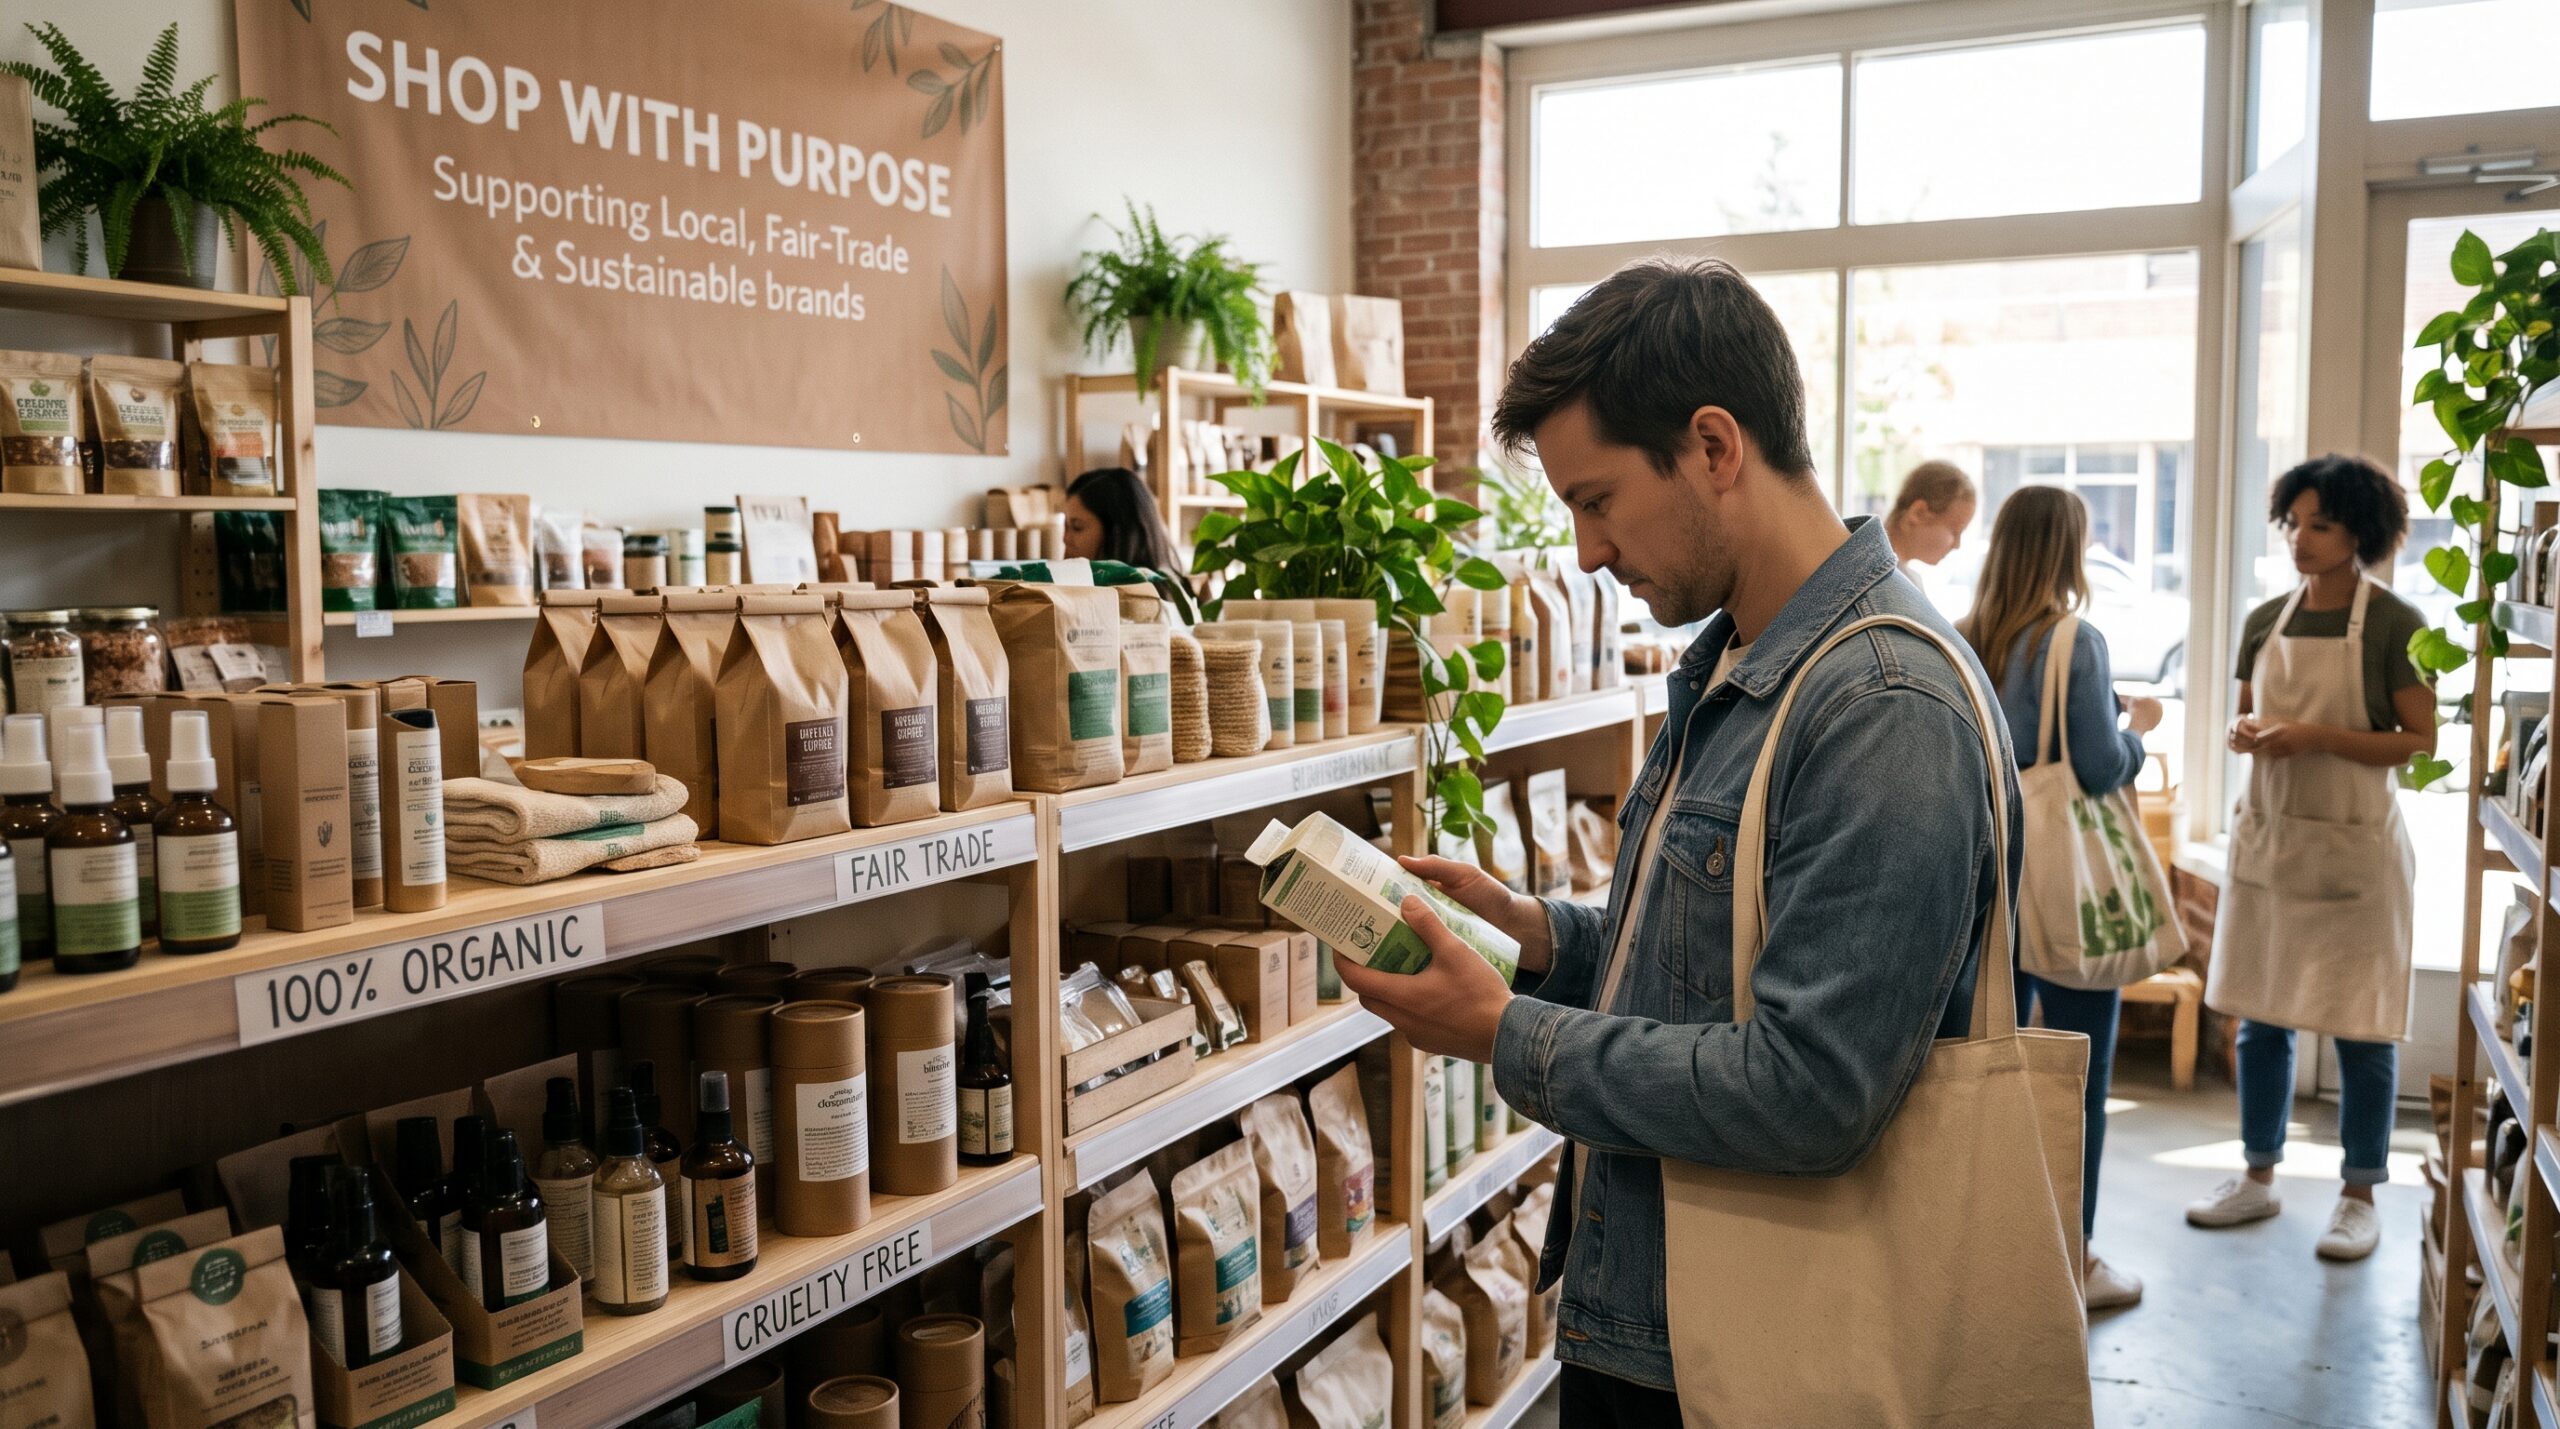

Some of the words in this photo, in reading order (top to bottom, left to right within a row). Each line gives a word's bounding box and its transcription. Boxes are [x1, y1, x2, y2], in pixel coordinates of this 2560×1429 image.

[346, 30, 542, 132] SHOP
[559, 79, 721, 173] WITH
[737, 118, 952, 218] PURPOSE
[433, 155, 652, 244] Supporting
[660, 195, 757, 258] Local,
[764, 213, 910, 275] Fair-Trade
[511, 234, 545, 281] &
[555, 240, 757, 309] Sustainable
[764, 269, 867, 322] brands
[851, 848, 910, 893] FAIR
[918, 829, 995, 877] TRADE
[267, 957, 377, 1029] 100%
[402, 915, 584, 995] ORGANIC
[734, 1263, 849, 1352] CRUELTY
[863, 1229, 924, 1292] FREE
